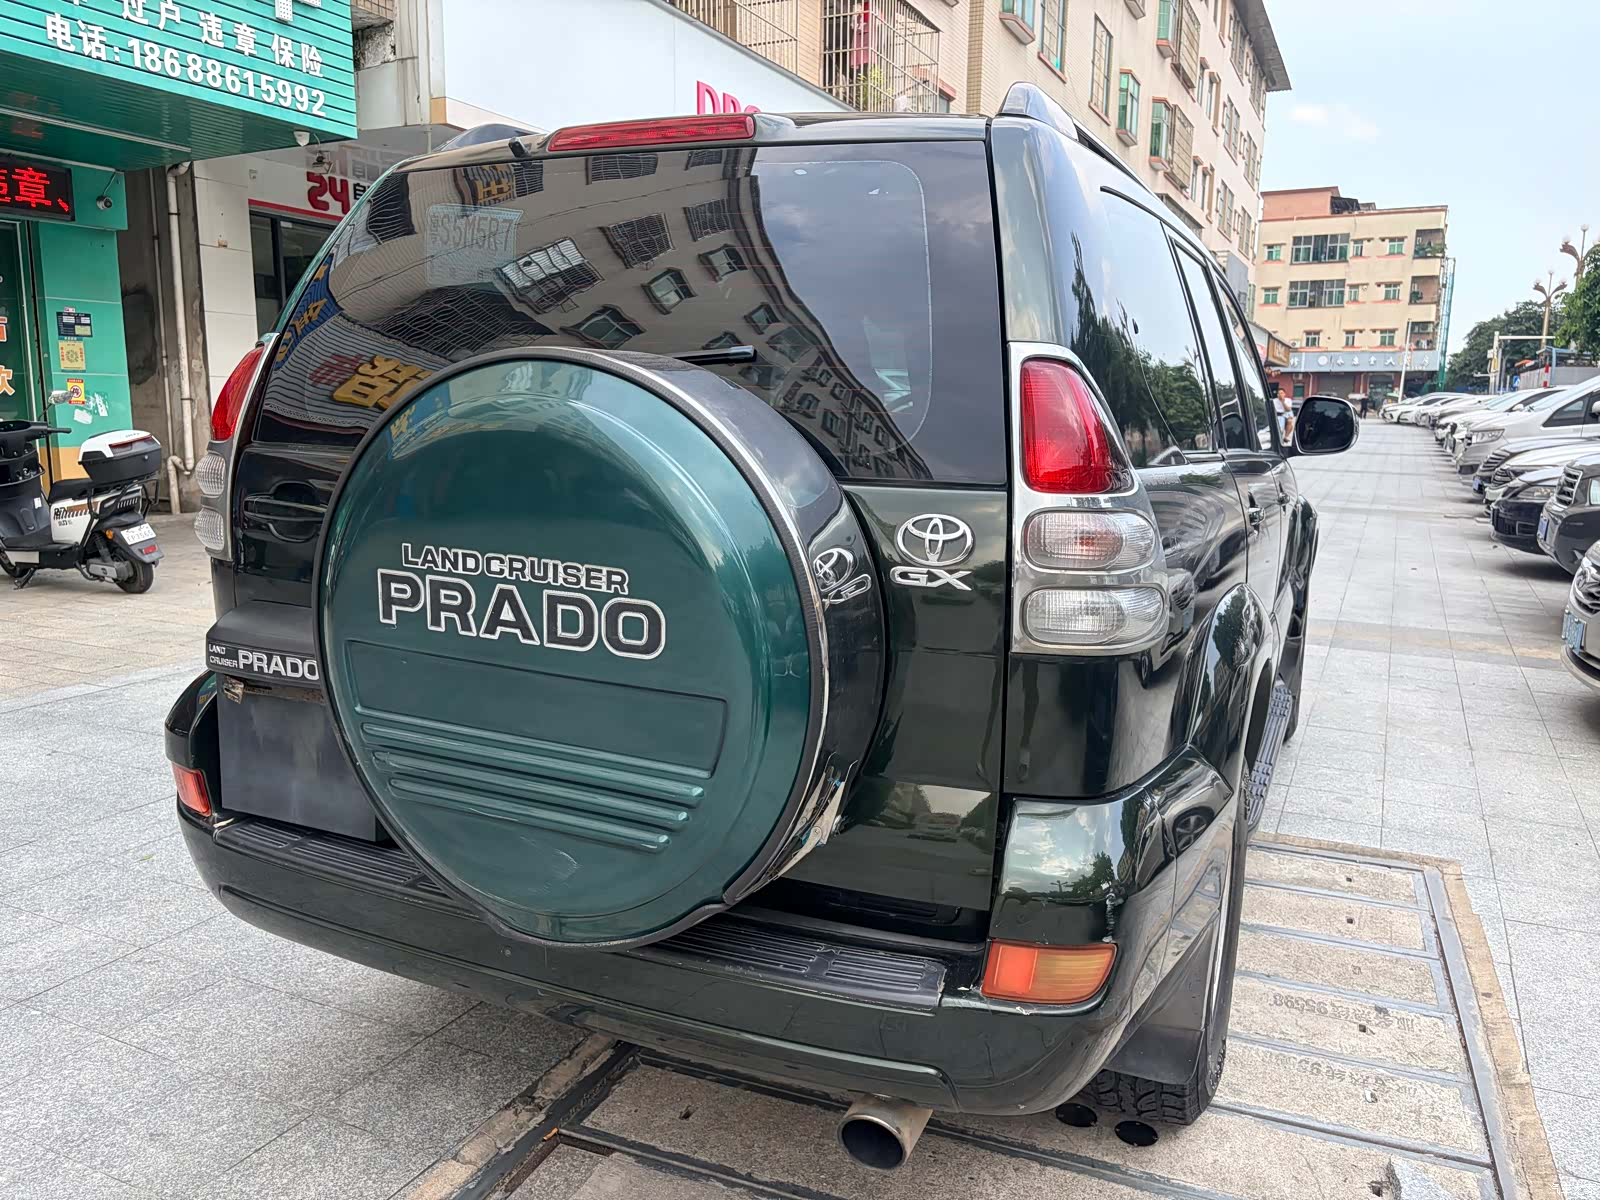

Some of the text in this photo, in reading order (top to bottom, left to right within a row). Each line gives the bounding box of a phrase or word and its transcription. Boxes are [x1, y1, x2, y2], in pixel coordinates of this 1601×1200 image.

[121, 0, 324, 78] 过户 违章 保险
[306, 171, 351, 215] 24
[401, 543, 629, 595] LAND CRUISER
[889, 565, 974, 591] GX
[377, 568, 667, 660] PRADO
[208, 643, 226, 655] LAND
[209, 655, 238, 669] CRUISER
[237, 649, 320, 680] PRADO
